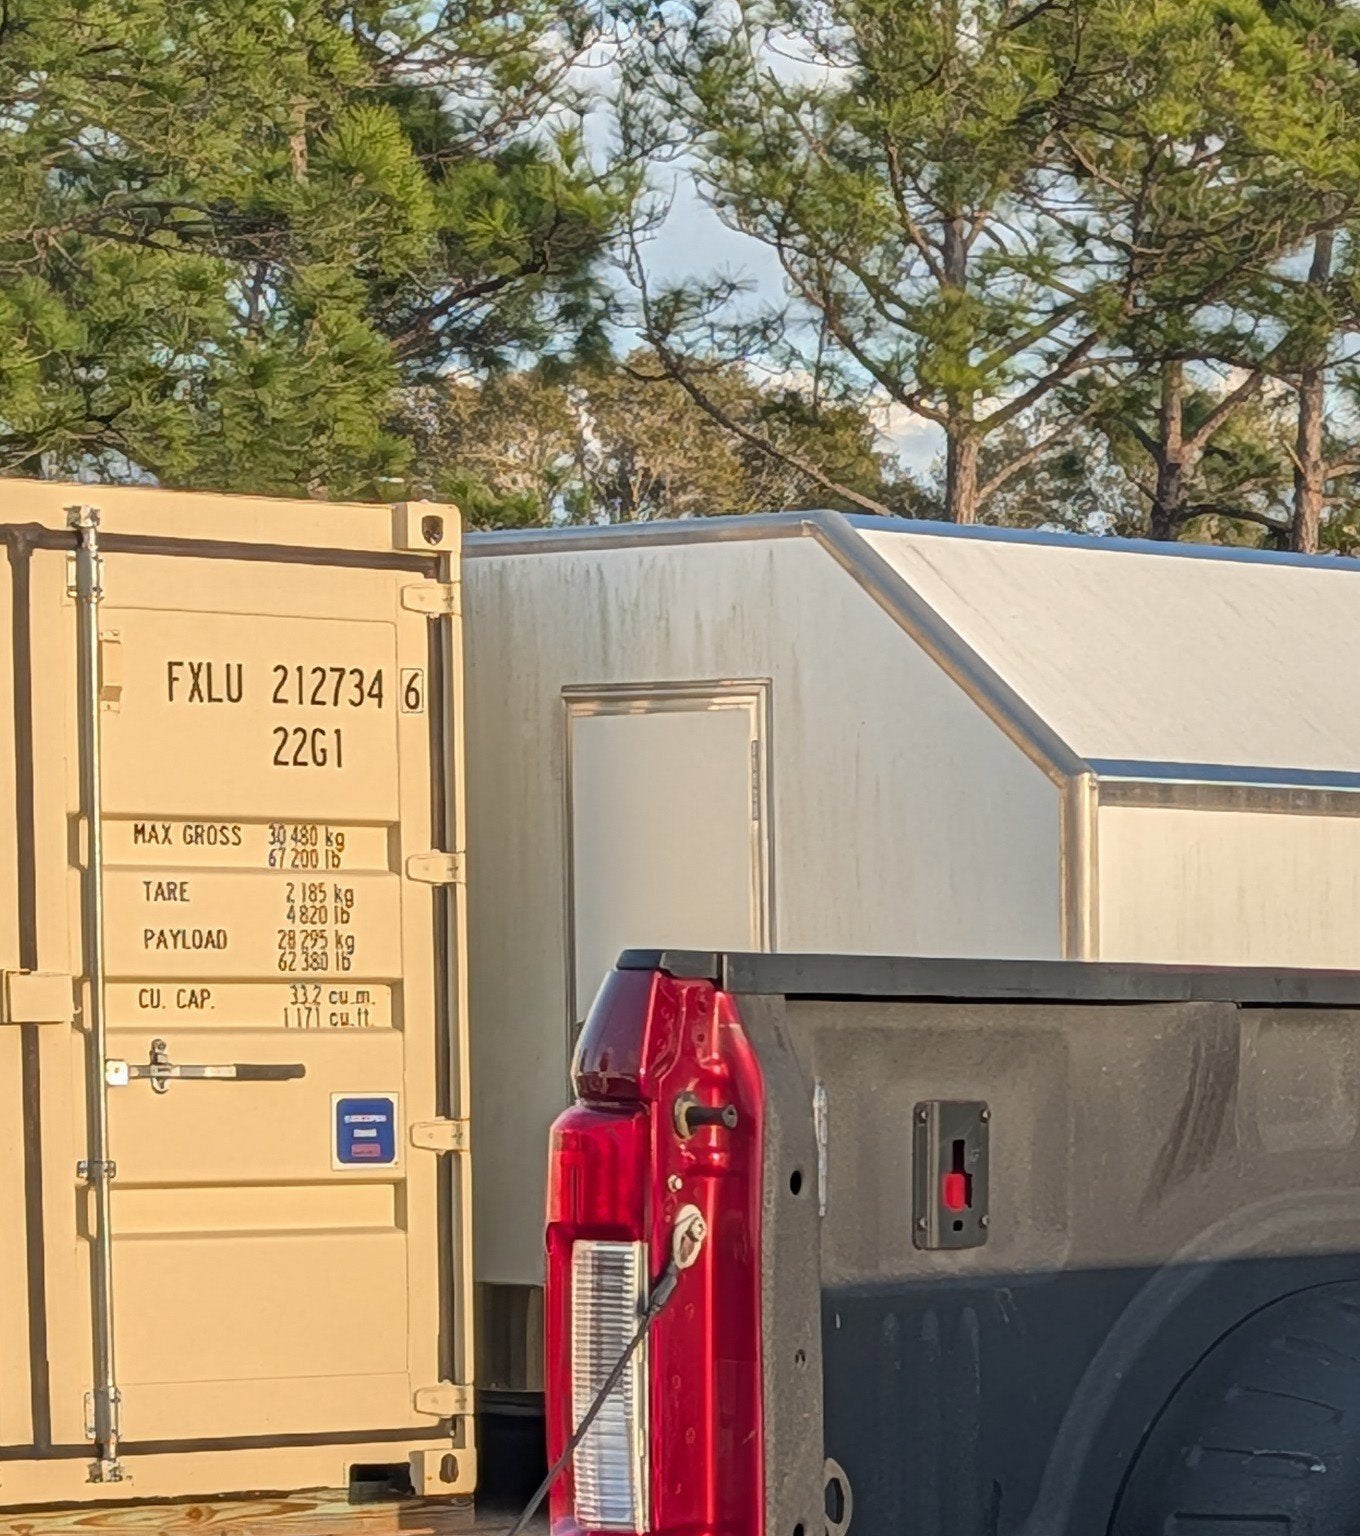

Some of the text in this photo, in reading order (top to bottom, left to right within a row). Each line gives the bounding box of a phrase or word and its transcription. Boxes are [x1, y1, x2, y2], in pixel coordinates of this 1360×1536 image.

[168, 662, 420, 710] FXLU 212734 6
[272, 726, 343, 768] 22G1
[134, 823, 172, 845] MAX
[183, 824, 242, 846] GROSS
[325, 826, 345, 853] kg
[325, 848, 341, 870] lb
[143, 881, 190, 902] TARE
[334, 883, 354, 909] kg
[334, 905, 351, 925] lb
[144, 929, 228, 950] PAYLOAD
[334, 929, 355, 955] kg
[336, 951, 352, 972] lb
[139, 988, 166, 1010] CU.
[176, 988, 215, 1010] CAP.
